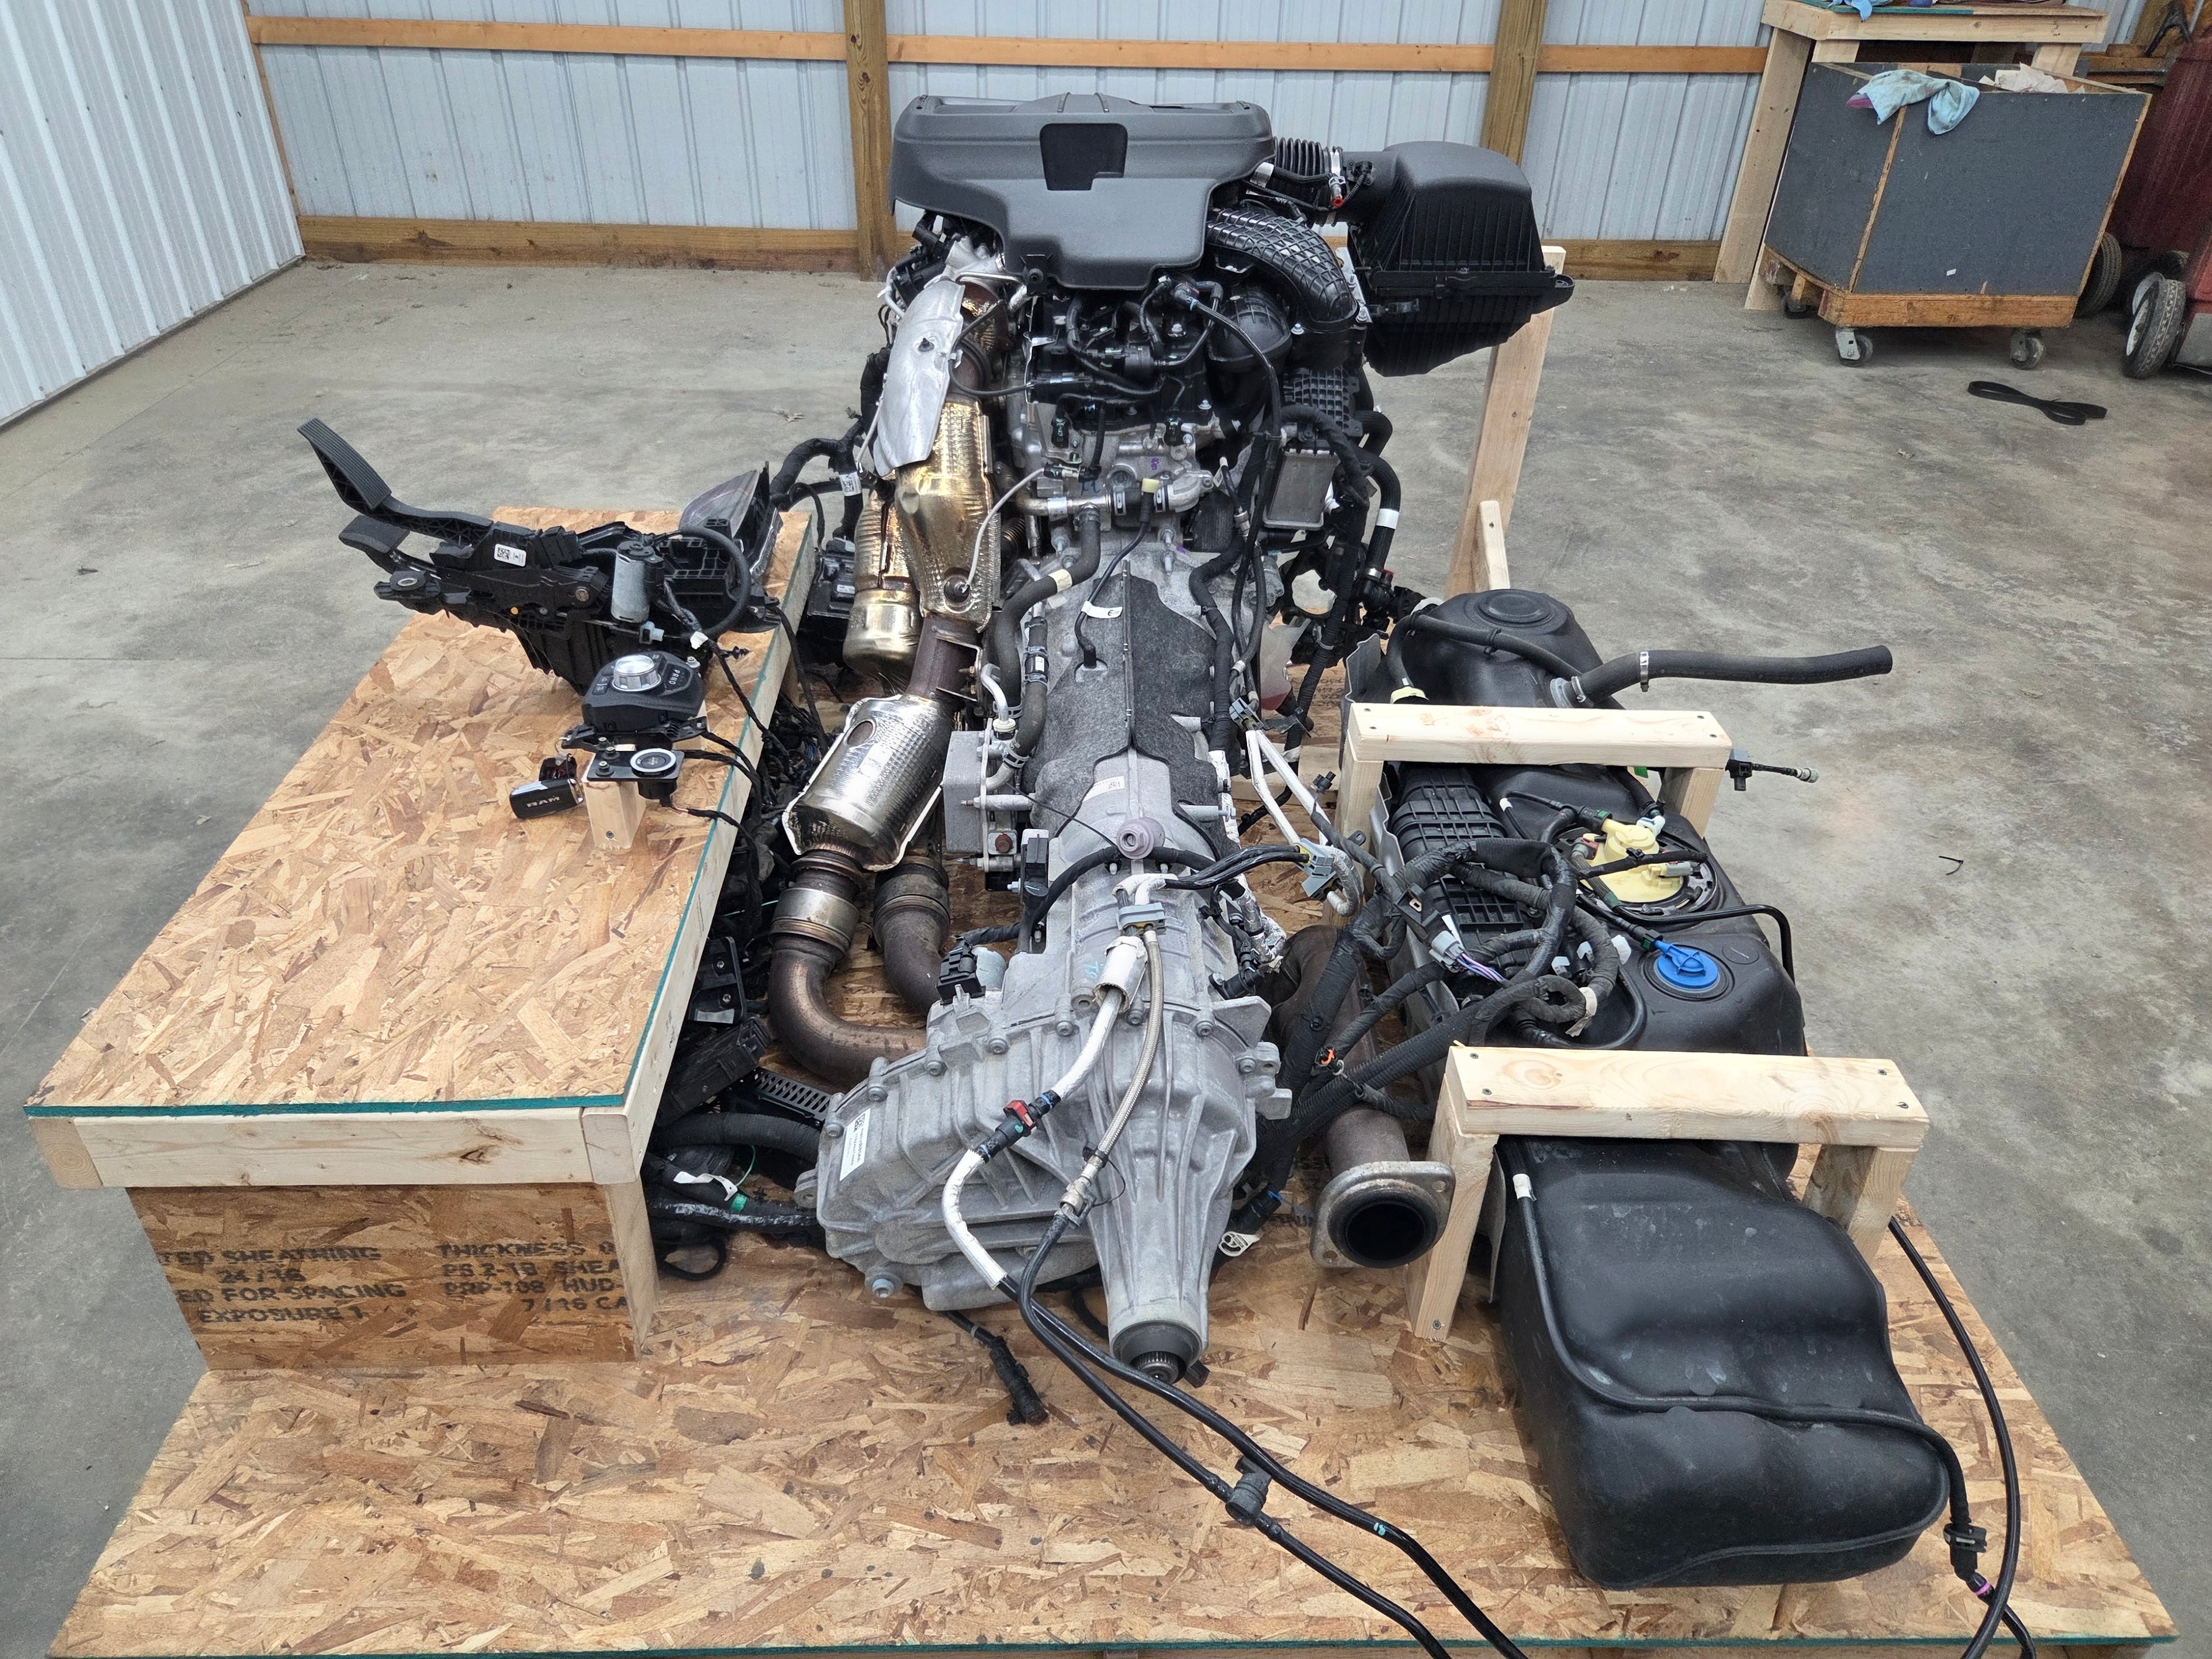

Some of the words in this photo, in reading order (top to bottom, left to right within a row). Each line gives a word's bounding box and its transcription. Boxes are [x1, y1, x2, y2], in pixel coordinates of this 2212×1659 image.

[527, 797, 560, 808] RAM
[221, 1246, 382, 1262] SHEATHING
[435, 1243, 587, 1257] THICKNESS
[221, 1286, 281, 1301] FOR
[284, 1284, 407, 1300] SPACING
[198, 1306, 344, 1323] EXPOSURE
[348, 1305, 363, 1319] 1
